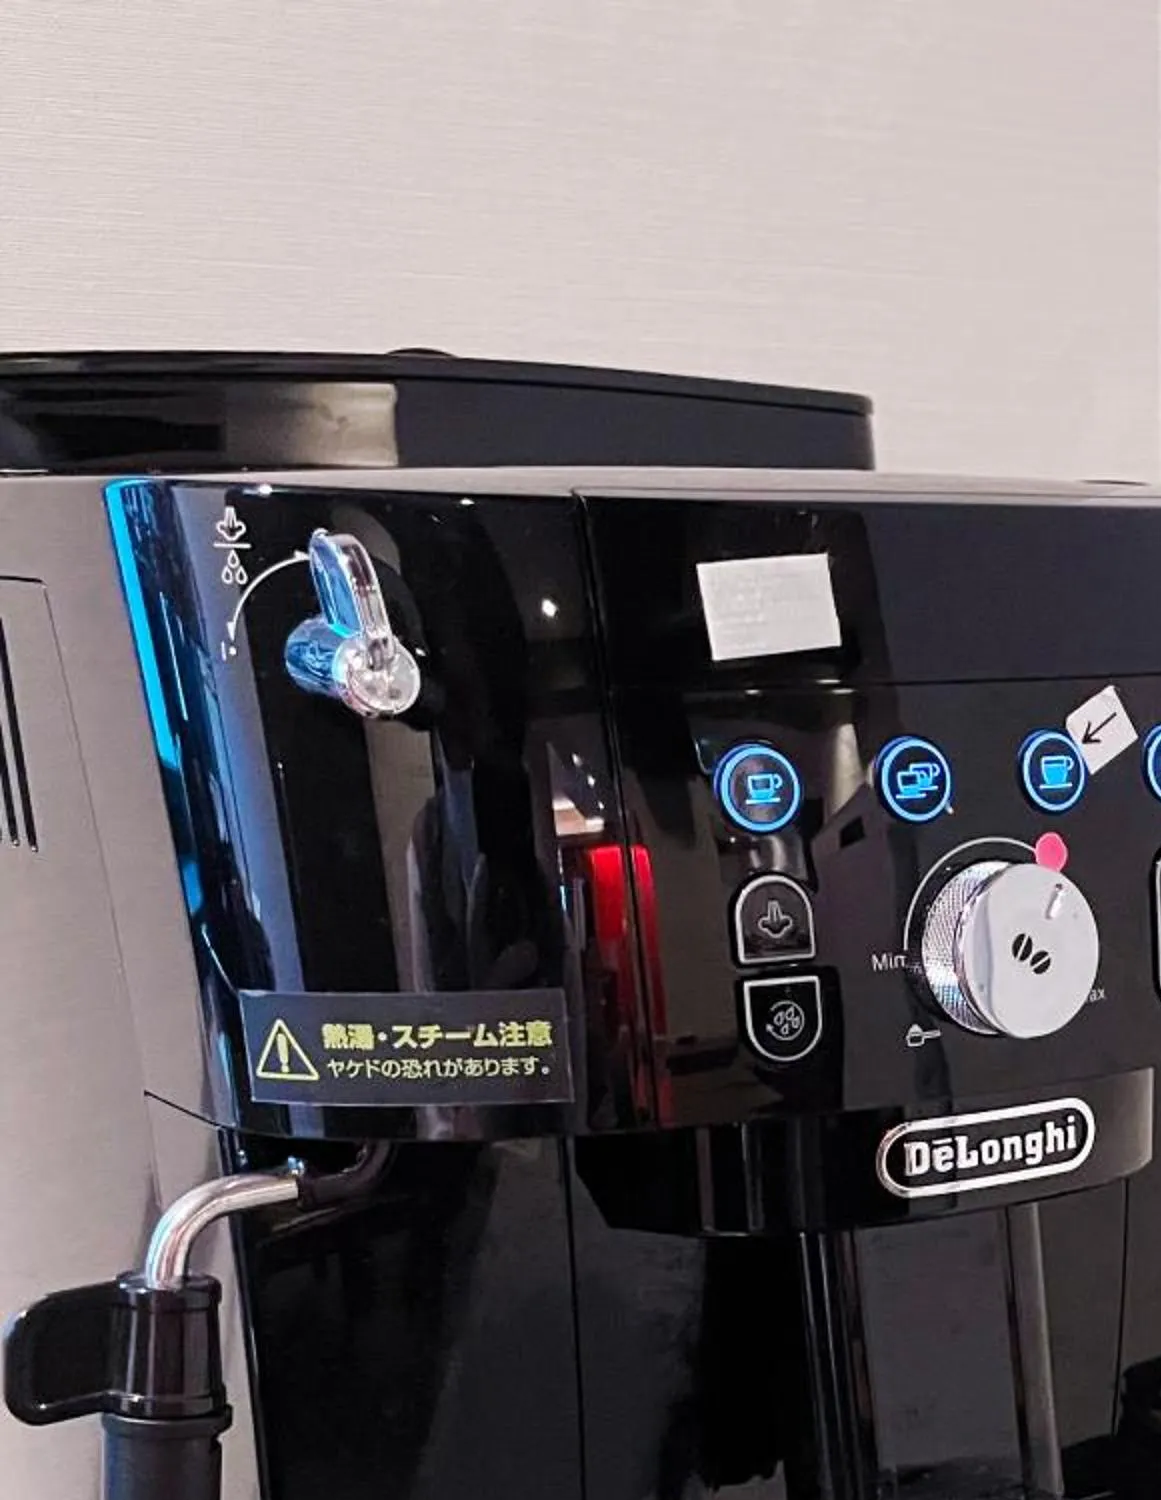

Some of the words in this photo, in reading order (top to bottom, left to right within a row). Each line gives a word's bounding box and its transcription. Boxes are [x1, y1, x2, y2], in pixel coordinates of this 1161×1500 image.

[871, 952, 907, 972] Min
[1089, 987, 1106, 1003] ax
[326, 1055, 551, 1080] ヤケドの恐れがあります。
